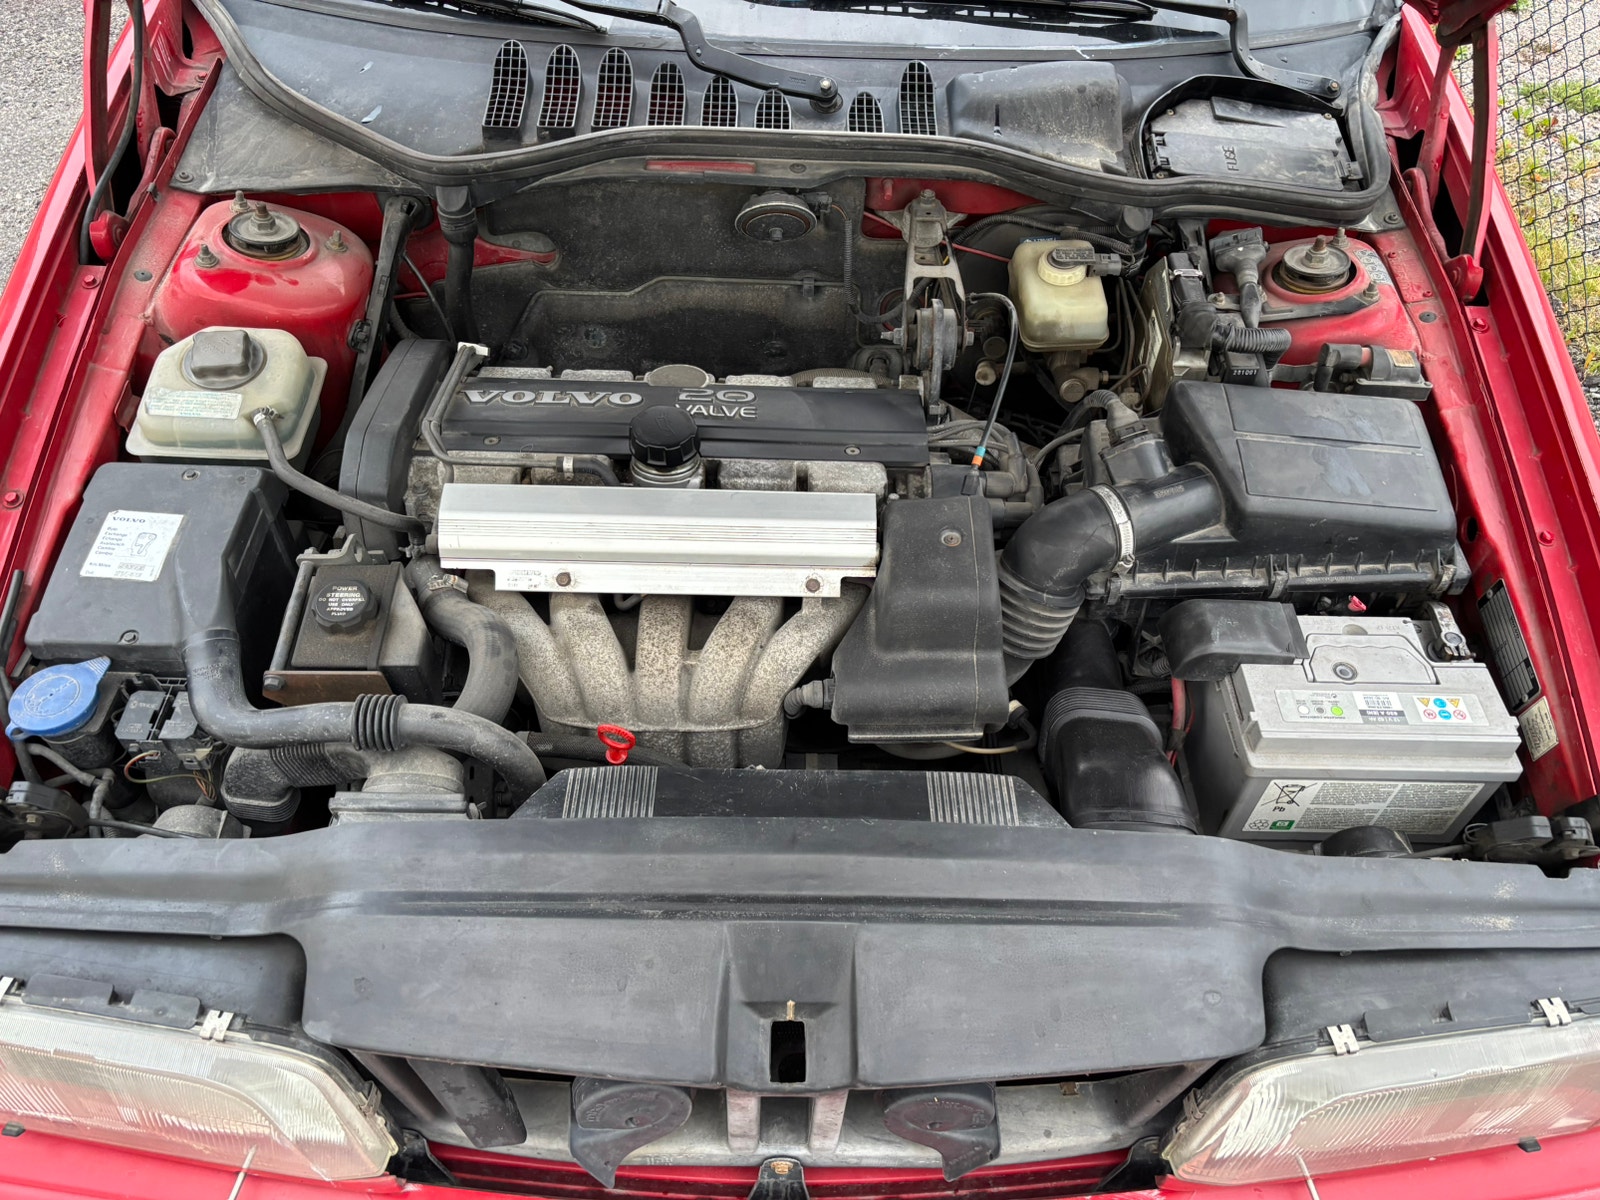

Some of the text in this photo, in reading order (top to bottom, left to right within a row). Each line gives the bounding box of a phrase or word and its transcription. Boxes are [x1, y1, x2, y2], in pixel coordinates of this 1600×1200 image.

[1222, 146, 1240, 171] FUSE
[460, 388, 757, 407] VOLVO 20
